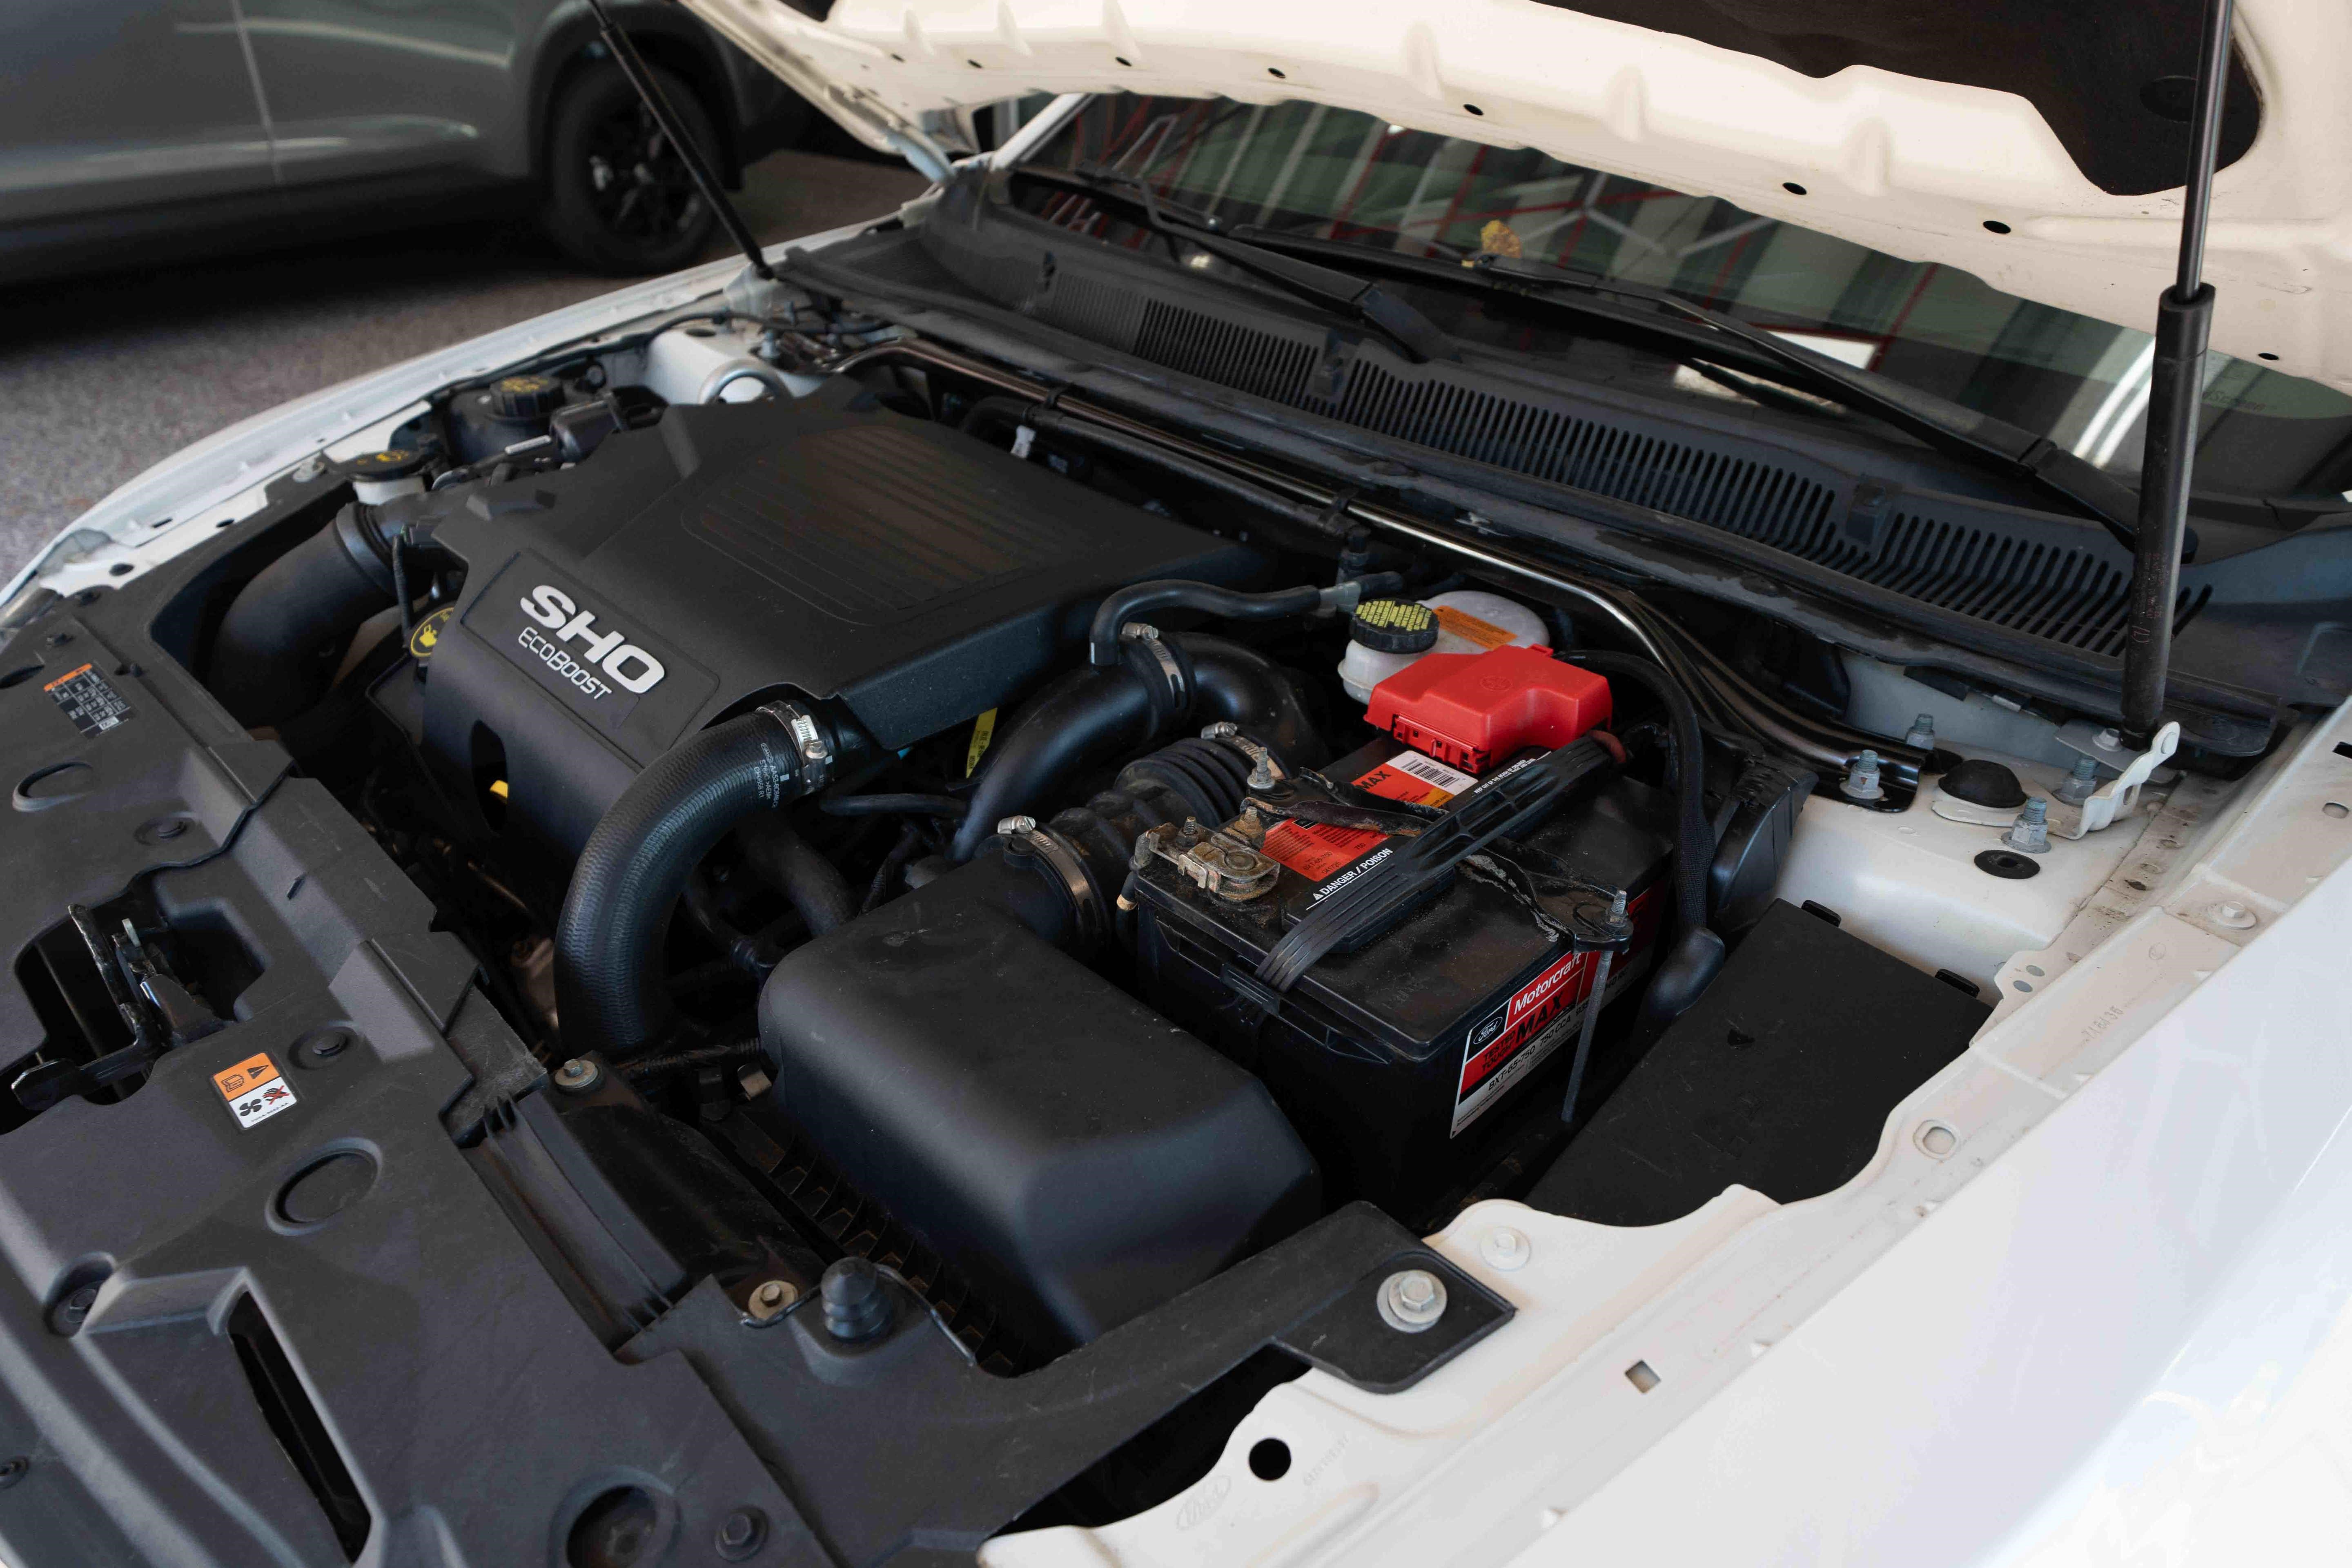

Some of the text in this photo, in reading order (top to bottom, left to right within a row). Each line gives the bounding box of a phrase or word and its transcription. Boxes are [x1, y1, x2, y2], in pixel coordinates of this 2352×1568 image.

[520, 585, 665, 694] SHO
[1355, 770, 1392, 790] MAX
[1319, 870, 1357, 895] DANGER
[1360, 848, 1394, 870] POISON
[1514, 952, 1582, 1015] Motorcraft
[1515, 991, 1564, 1043] MAX
[1488, 1045, 1535, 1091] BXT-65-750
[1540, 1029, 1554, 1046] 750
[1555, 1015, 1571, 1033] CCA
